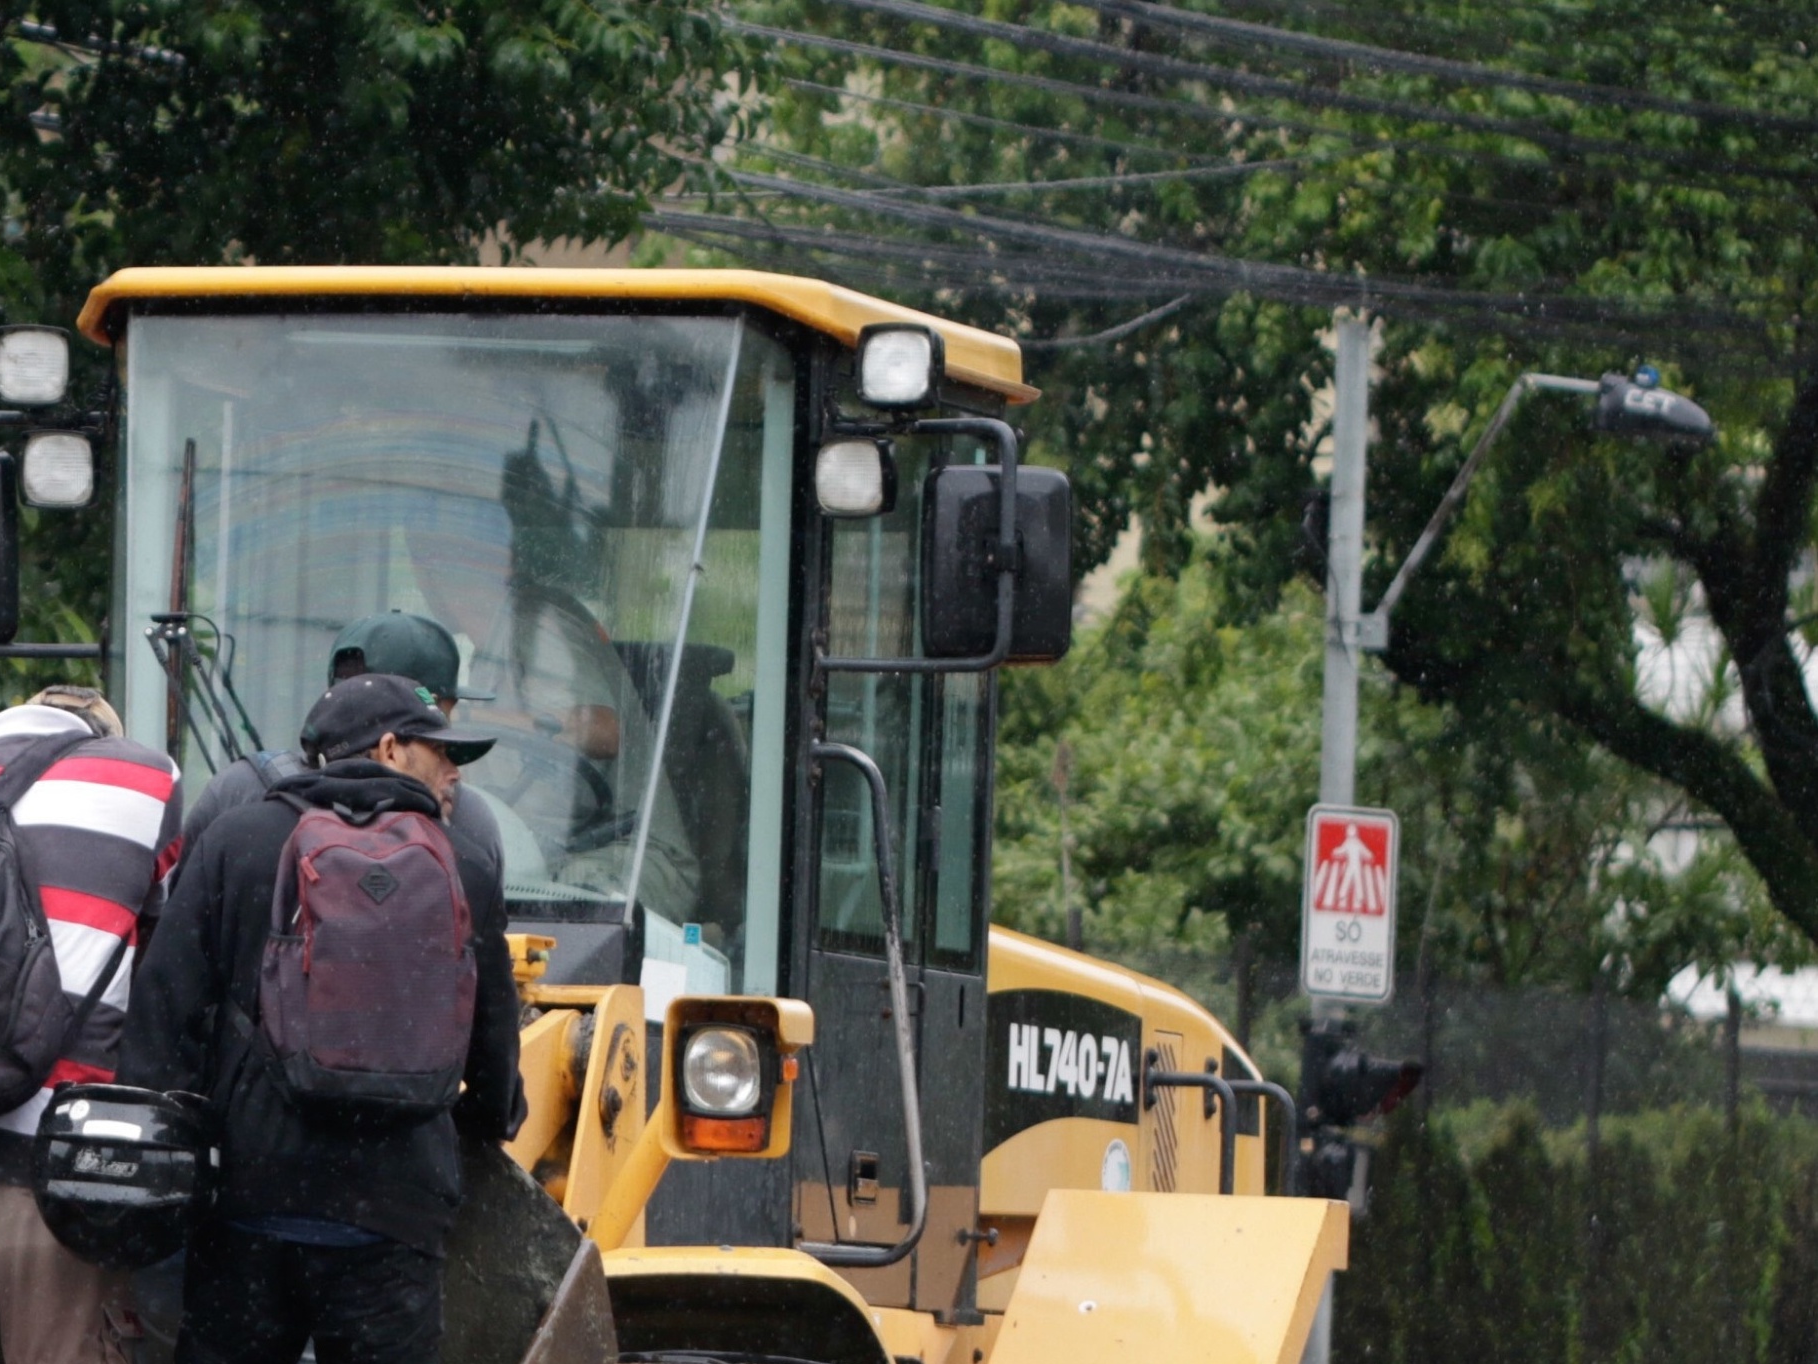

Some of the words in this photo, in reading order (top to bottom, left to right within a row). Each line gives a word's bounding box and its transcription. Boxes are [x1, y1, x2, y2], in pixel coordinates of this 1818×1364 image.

[1311, 947, 1383, 968] ATRAVESSE
[1314, 967, 1333, 985] NO
[1339, 969, 1382, 989] VERDE
[1008, 1022, 1133, 1102] HL740-7A
